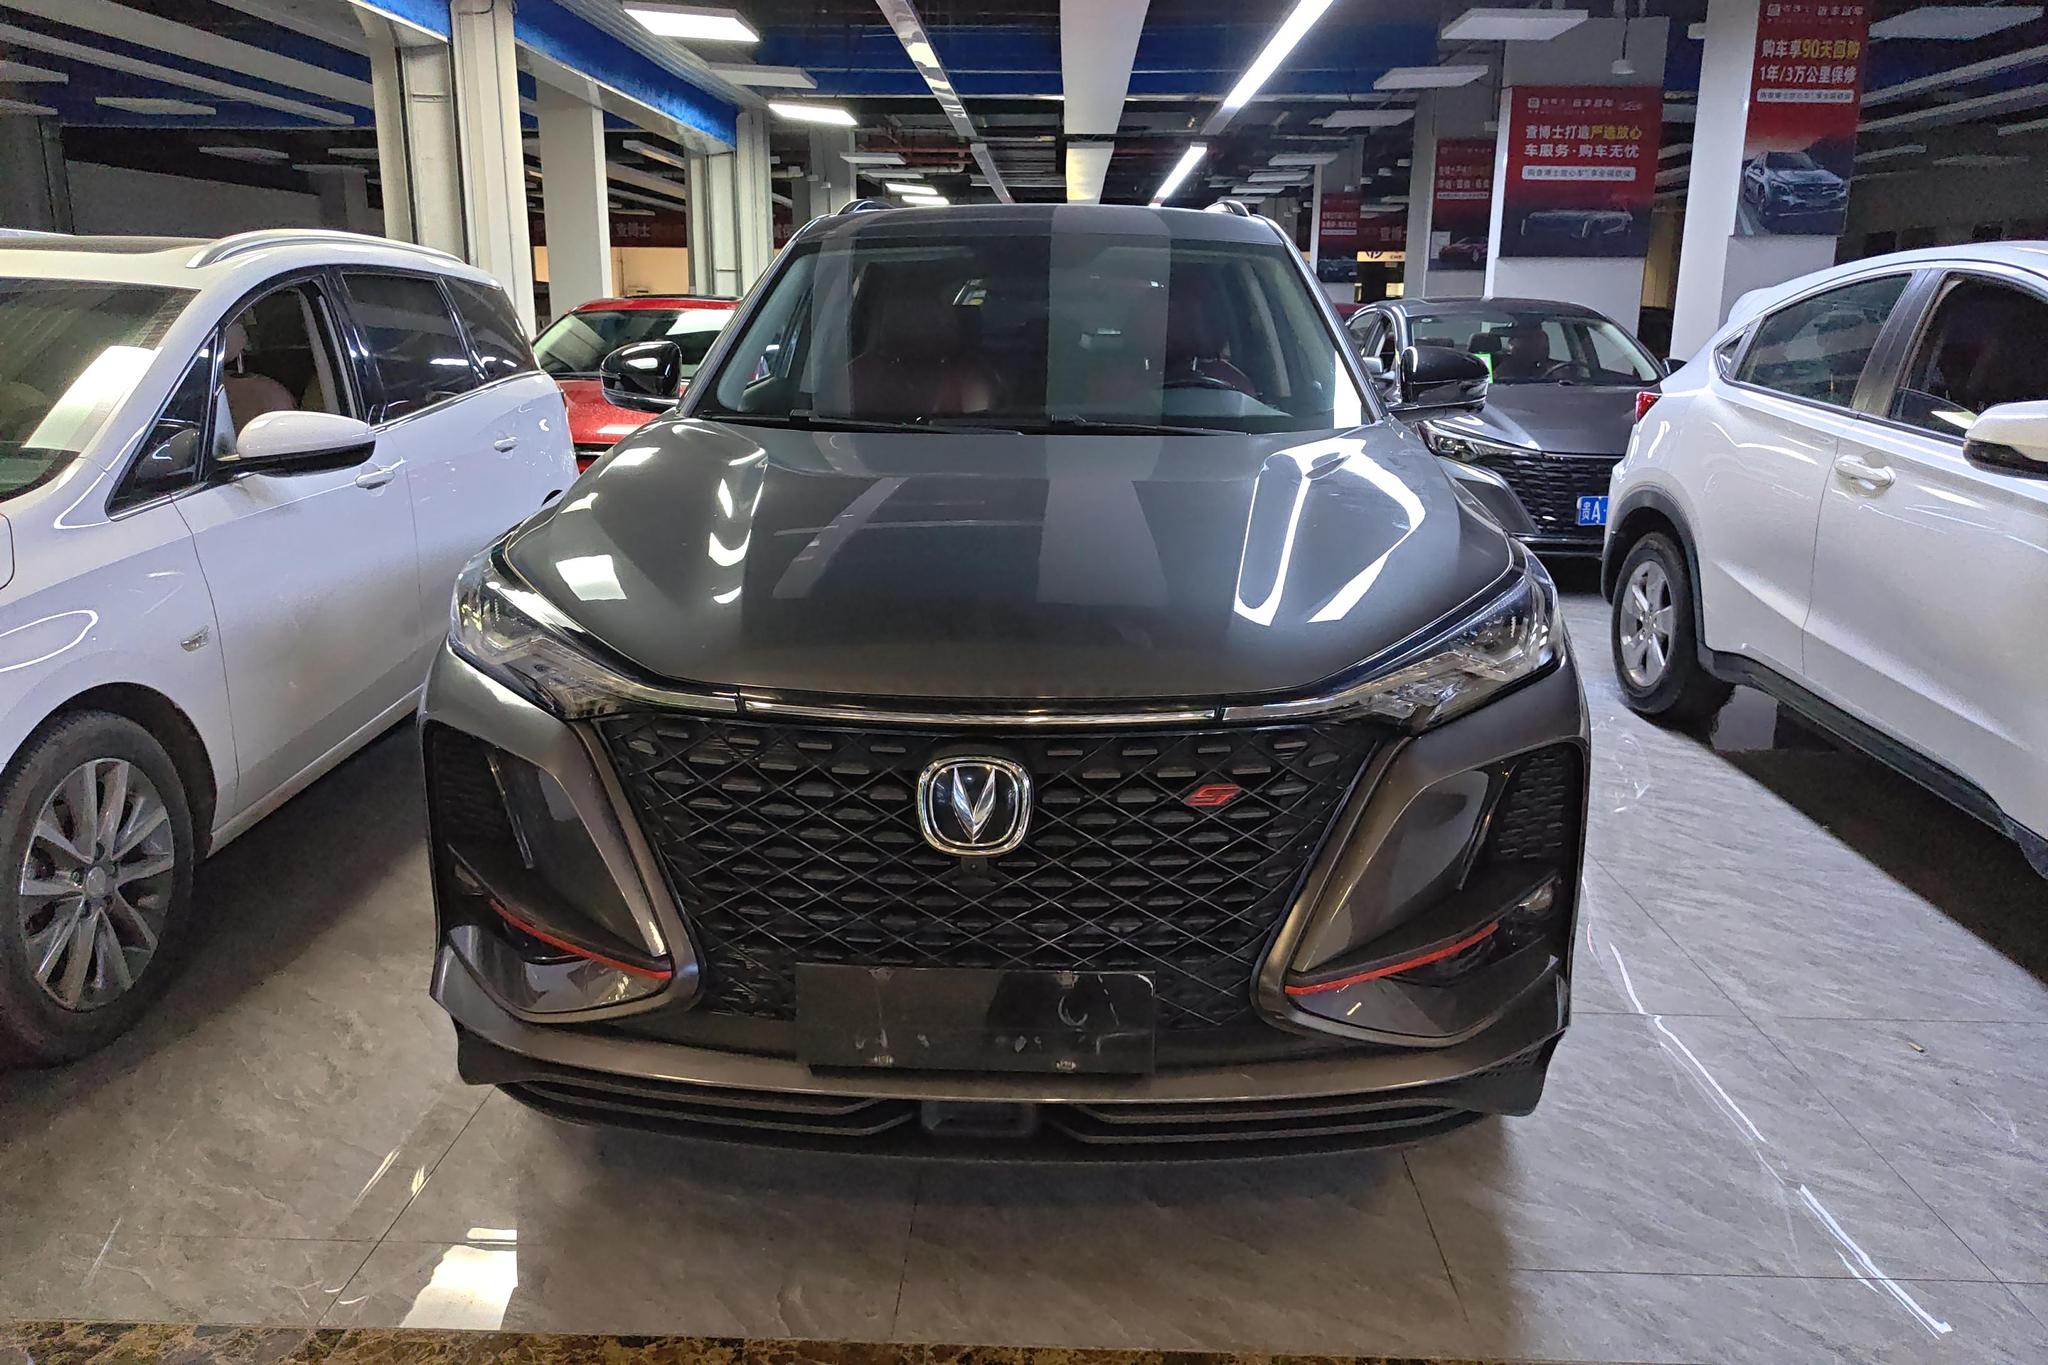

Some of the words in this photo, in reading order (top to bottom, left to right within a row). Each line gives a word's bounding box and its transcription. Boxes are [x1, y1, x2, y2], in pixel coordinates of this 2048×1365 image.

[1761, 39, 1860, 58] 购车享90天回购
[1760, 64, 1857, 84] 1年/3万公里保修
[1526, 125, 1642, 140] 查博士打造严选放心
[1524, 143, 1640, 158] 车服务·购车无忧
